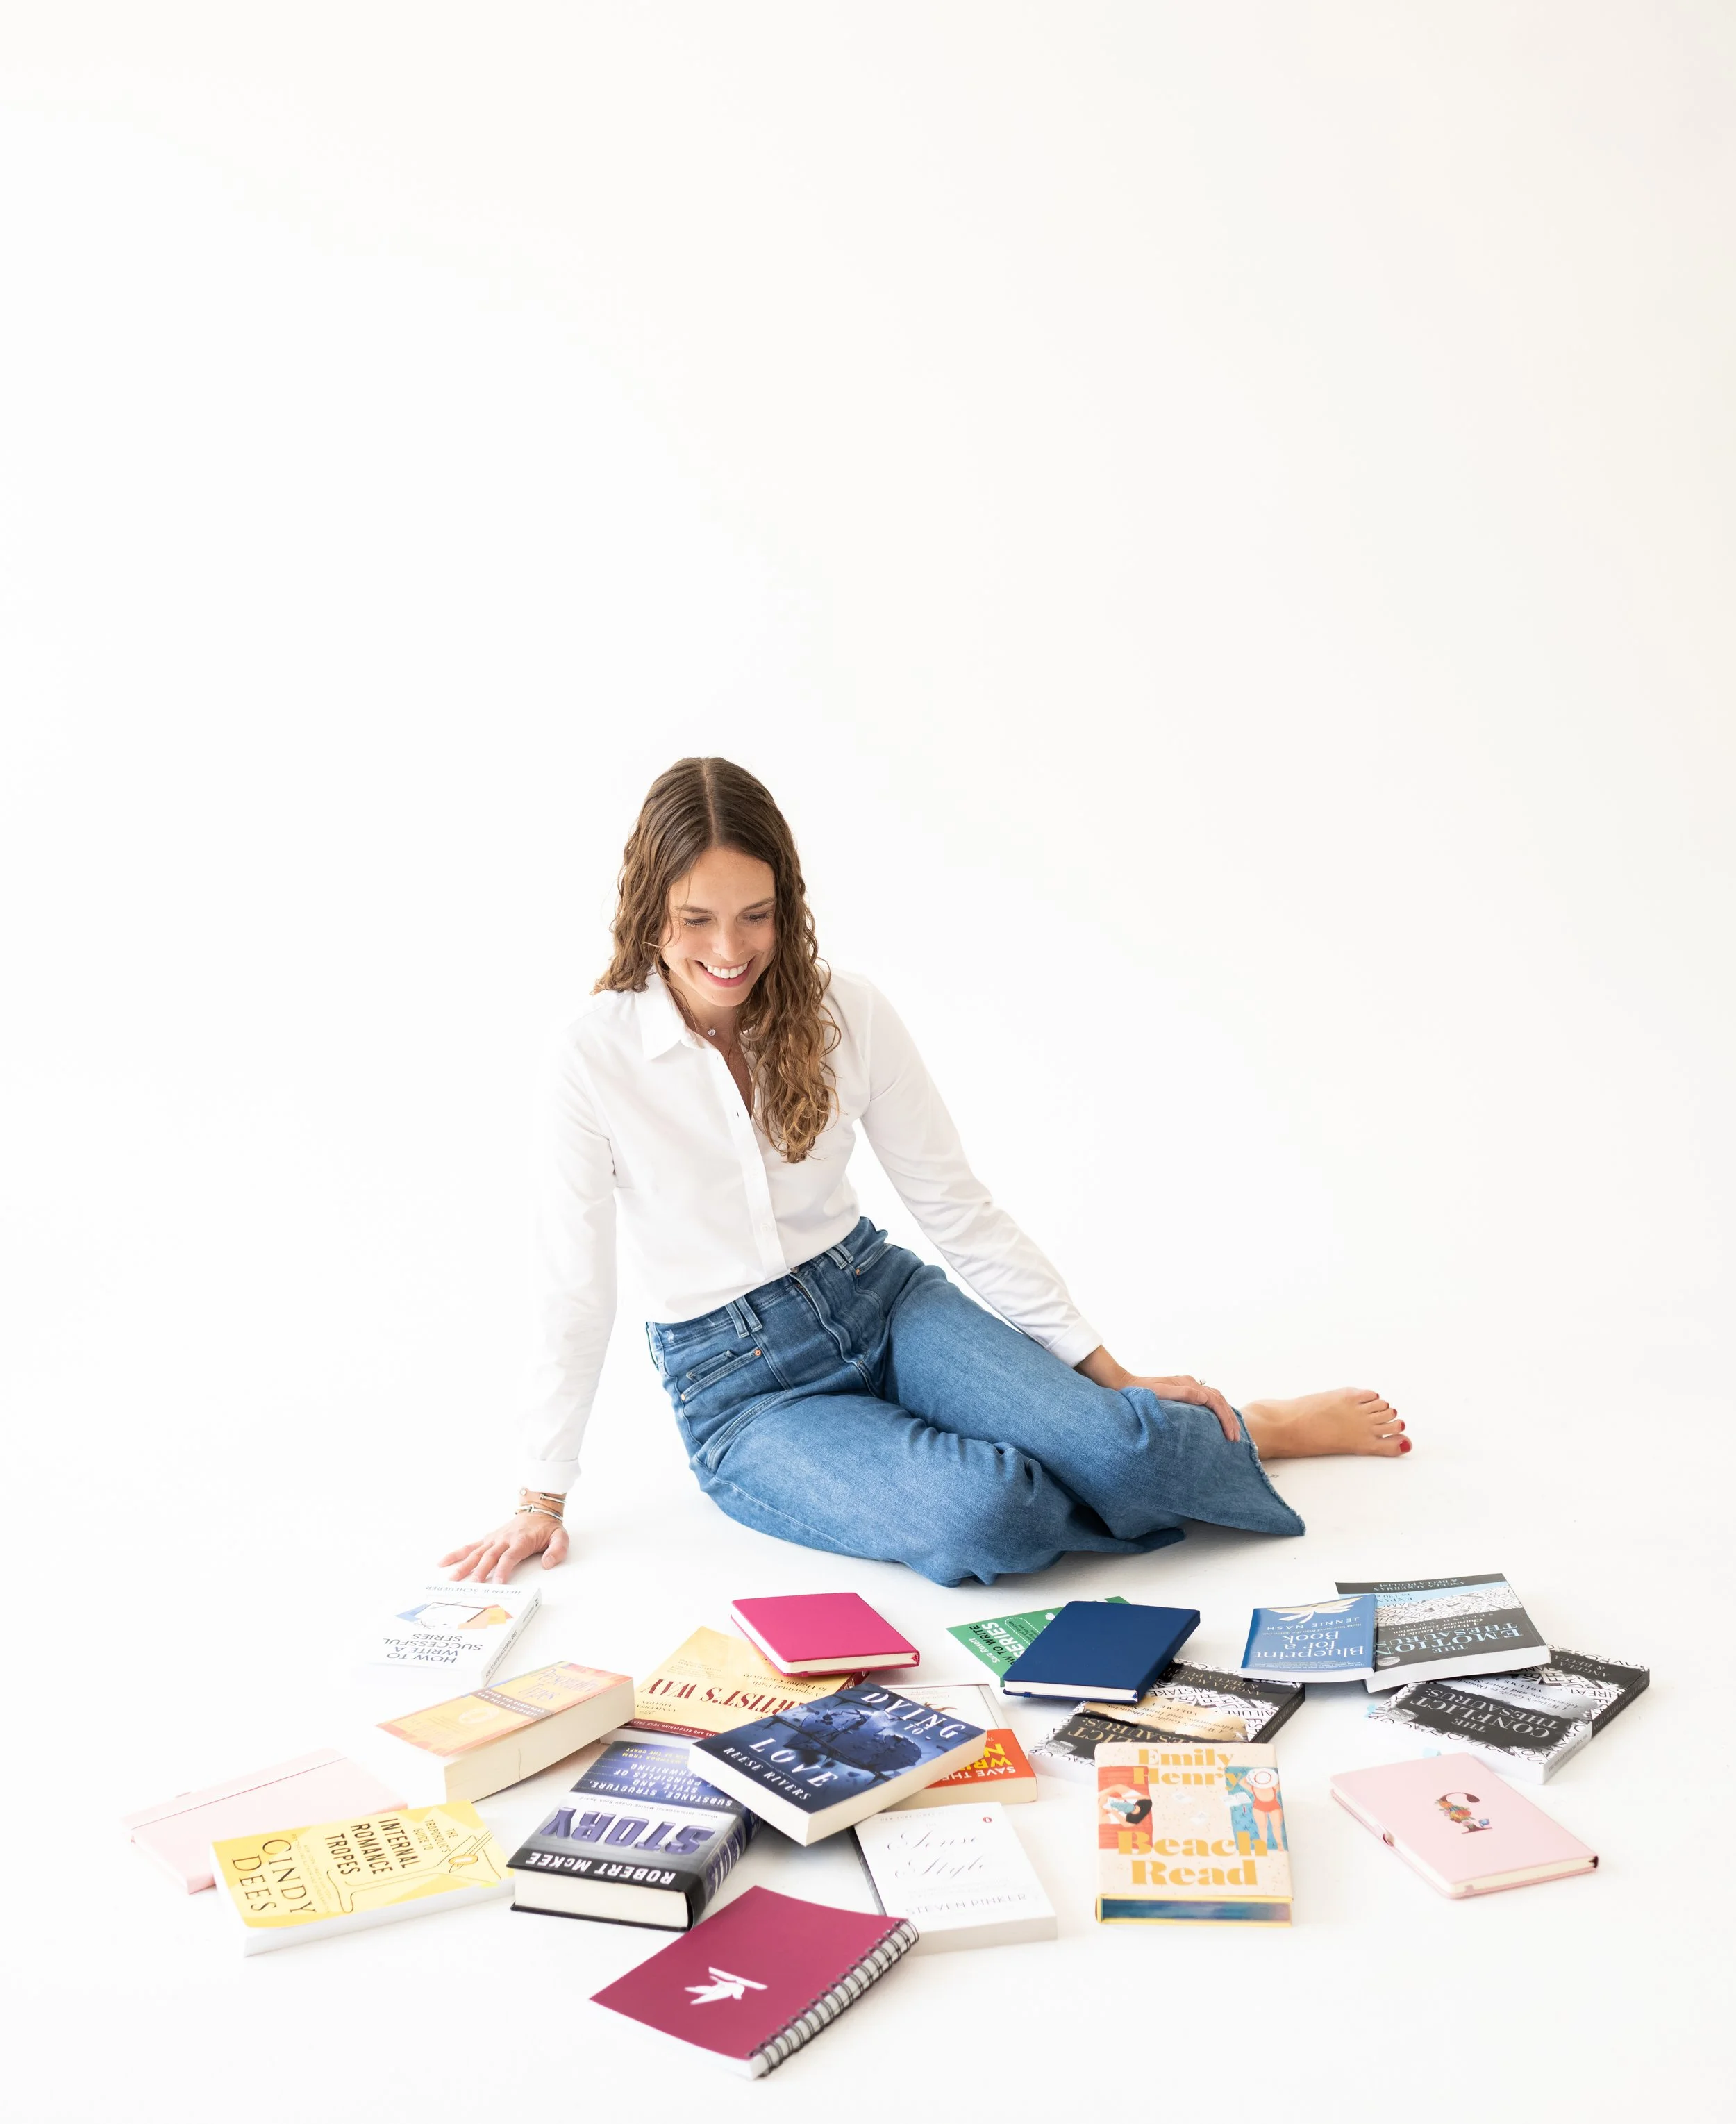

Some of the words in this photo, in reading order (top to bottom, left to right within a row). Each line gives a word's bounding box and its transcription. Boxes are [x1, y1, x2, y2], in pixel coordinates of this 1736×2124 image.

[1312, 1616, 1360, 1627] JENNIE
[411, 1633, 463, 1642] SERIES
[969, 1625, 997, 1646] WRITE
[1281, 1630, 1339, 1645] Book
[1376, 1629, 1524, 1655] EMOTION
[383, 1638, 483, 1651] SUCCESSFUL
[408, 1647, 459, 1657] WRITE
[993, 1645, 1008, 1655] TO
[1253, 1645, 1364, 1659] Blueprint
[1303, 1640, 1336, 1650] for
[1433, 1644, 1468, 1653] THE
[412, 1654, 458, 1664] HOW
[986, 1652, 1001, 1663] Sara
[1555, 1654, 1593, 1668] BECCA
[742, 1673, 783, 1684] Creativity
[786, 1678, 815, 1689] Higher
[1504, 1679, 1542, 1693] VOLUME
[640, 1678, 698, 1700] WAY
[774, 1684, 815, 1695] Spiritual
[1150, 1686, 1212, 1698] MISTAKE
[1500, 1690, 1524, 1700] Guide
[1512, 1688, 1528, 1696] and
[699, 1686, 806, 1715] RTIST'S
[1424, 1687, 1561, 1729] THESAURUS:
[635, 1704, 678, 1714] ANNIVERSA
[860, 1692, 967, 1739] DYING
[1410, 1696, 1550, 1738] CONFLICT
[903, 1723, 924, 1735] TO
[1451, 1718, 1486, 1733] THE
[749, 1737, 839, 1788] LOVE
[1138, 1748, 1235, 1770] Emily
[633, 1772, 703, 1786] PRINCIPLES
[723, 1746, 764, 1772] REESE
[763, 1770, 812, 1801] RIVERS
[975, 1766, 1017, 1777] SAVE
[1133, 1766, 1242, 1791] Henry
[590, 1779, 658, 1797] STRUCTURE,
[632, 1779, 656, 1788] AND
[661, 1781, 699, 1794] STYLE,
[663, 1790, 733, 1807] SUBSTANCE,
[413, 1827, 430, 1843] GUIDE
[445, 1827, 458, 1839] THE
[540, 1807, 716, 1855] STORY
[350, 1823, 394, 1875] ROMANCE
[378, 1818, 421, 1869] INTERNAL
[1116, 1830, 1269, 1857] Beach
[324, 1832, 361, 1875] TROPES
[525, 1852, 592, 1873] McKEE
[262, 1839, 317, 1913] CINDY
[594, 1862, 676, 1885] ROBERT
[1130, 1859, 1258, 1886] Read
[232, 1855, 277, 1912] DEES
